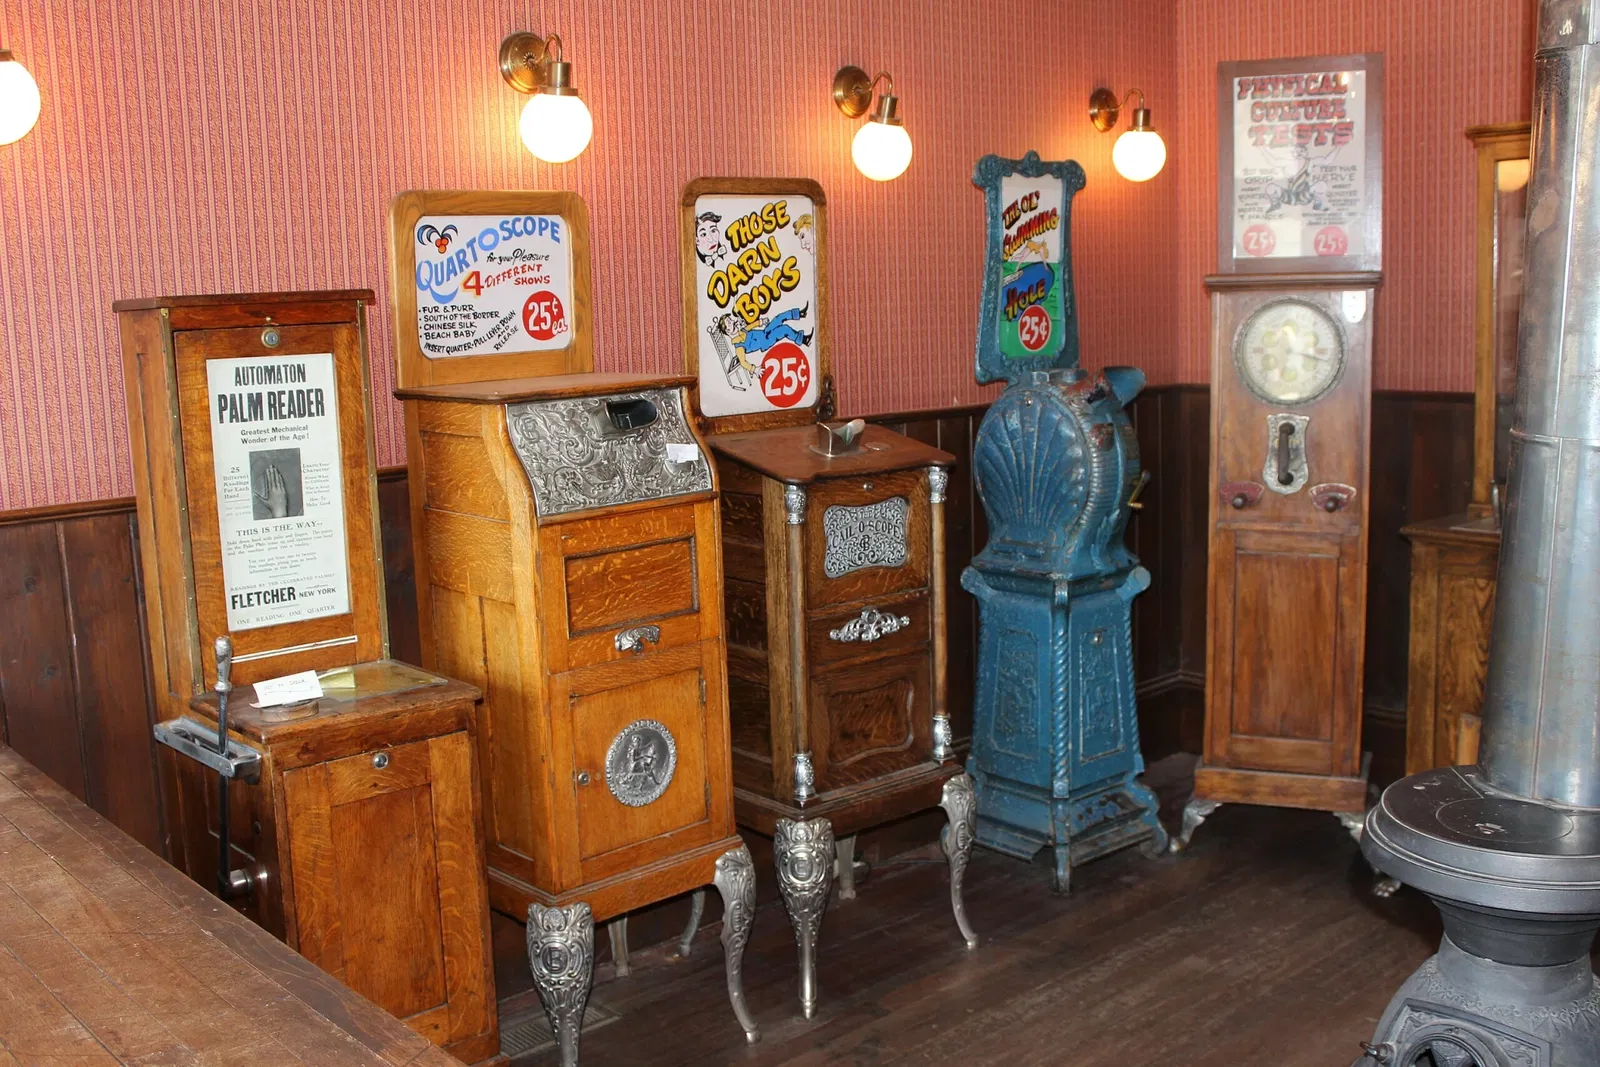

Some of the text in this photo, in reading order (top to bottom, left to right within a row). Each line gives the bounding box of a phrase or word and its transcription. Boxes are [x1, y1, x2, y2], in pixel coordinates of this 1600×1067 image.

[1238, 72, 1348, 99] PHYSICAL
[1251, 98, 1346, 122] CULTURE
[1248, 122, 1354, 148] TESTS
[1312, 172, 1355, 182] NERVE
[725, 200, 790, 250] THOSE
[1002, 199, 1021, 230] THE
[1002, 208, 1059, 262] SWIMMING
[486, 248, 550, 265] for your Pleasure
[462, 264, 542, 297] 4 DIFFERENT
[514, 276, 550, 286] SHOWS
[707, 236, 782, 309] DARN
[732, 256, 800, 324] BOYS
[1005, 278, 1046, 322] HOLE
[450, 304, 474, 312] PURR
[473, 311, 500, 320] BORDER
[528, 297, 558, 332] 25¢
[424, 322, 456, 330] CHINESE
[424, 342, 446, 354] INSERT
[486, 324, 502, 340] LEVER
[500, 310, 516, 328] DOWN
[424, 330, 476, 340] BEACH BABY
[494, 324, 519, 351] RELEASE
[497, 325, 510, 339] AND
[1021, 315, 1048, 344] 25¢
[234, 364, 306, 386] AUTOMATON
[764, 356, 808, 398] 25¢
[218, 388, 325, 424] PALM READER
[240, 424, 308, 436] Greatest Mechanical
[236, 528, 258, 537] THIS
[262, 526, 270, 534] IS
[280, 576, 313, 585] CELEBRATED
[231, 586, 296, 610] FLETCHER
[318, 587, 336, 595] YORK
[256, 614, 284, 622] READING
[307, 605, 335, 614] QUARTER
